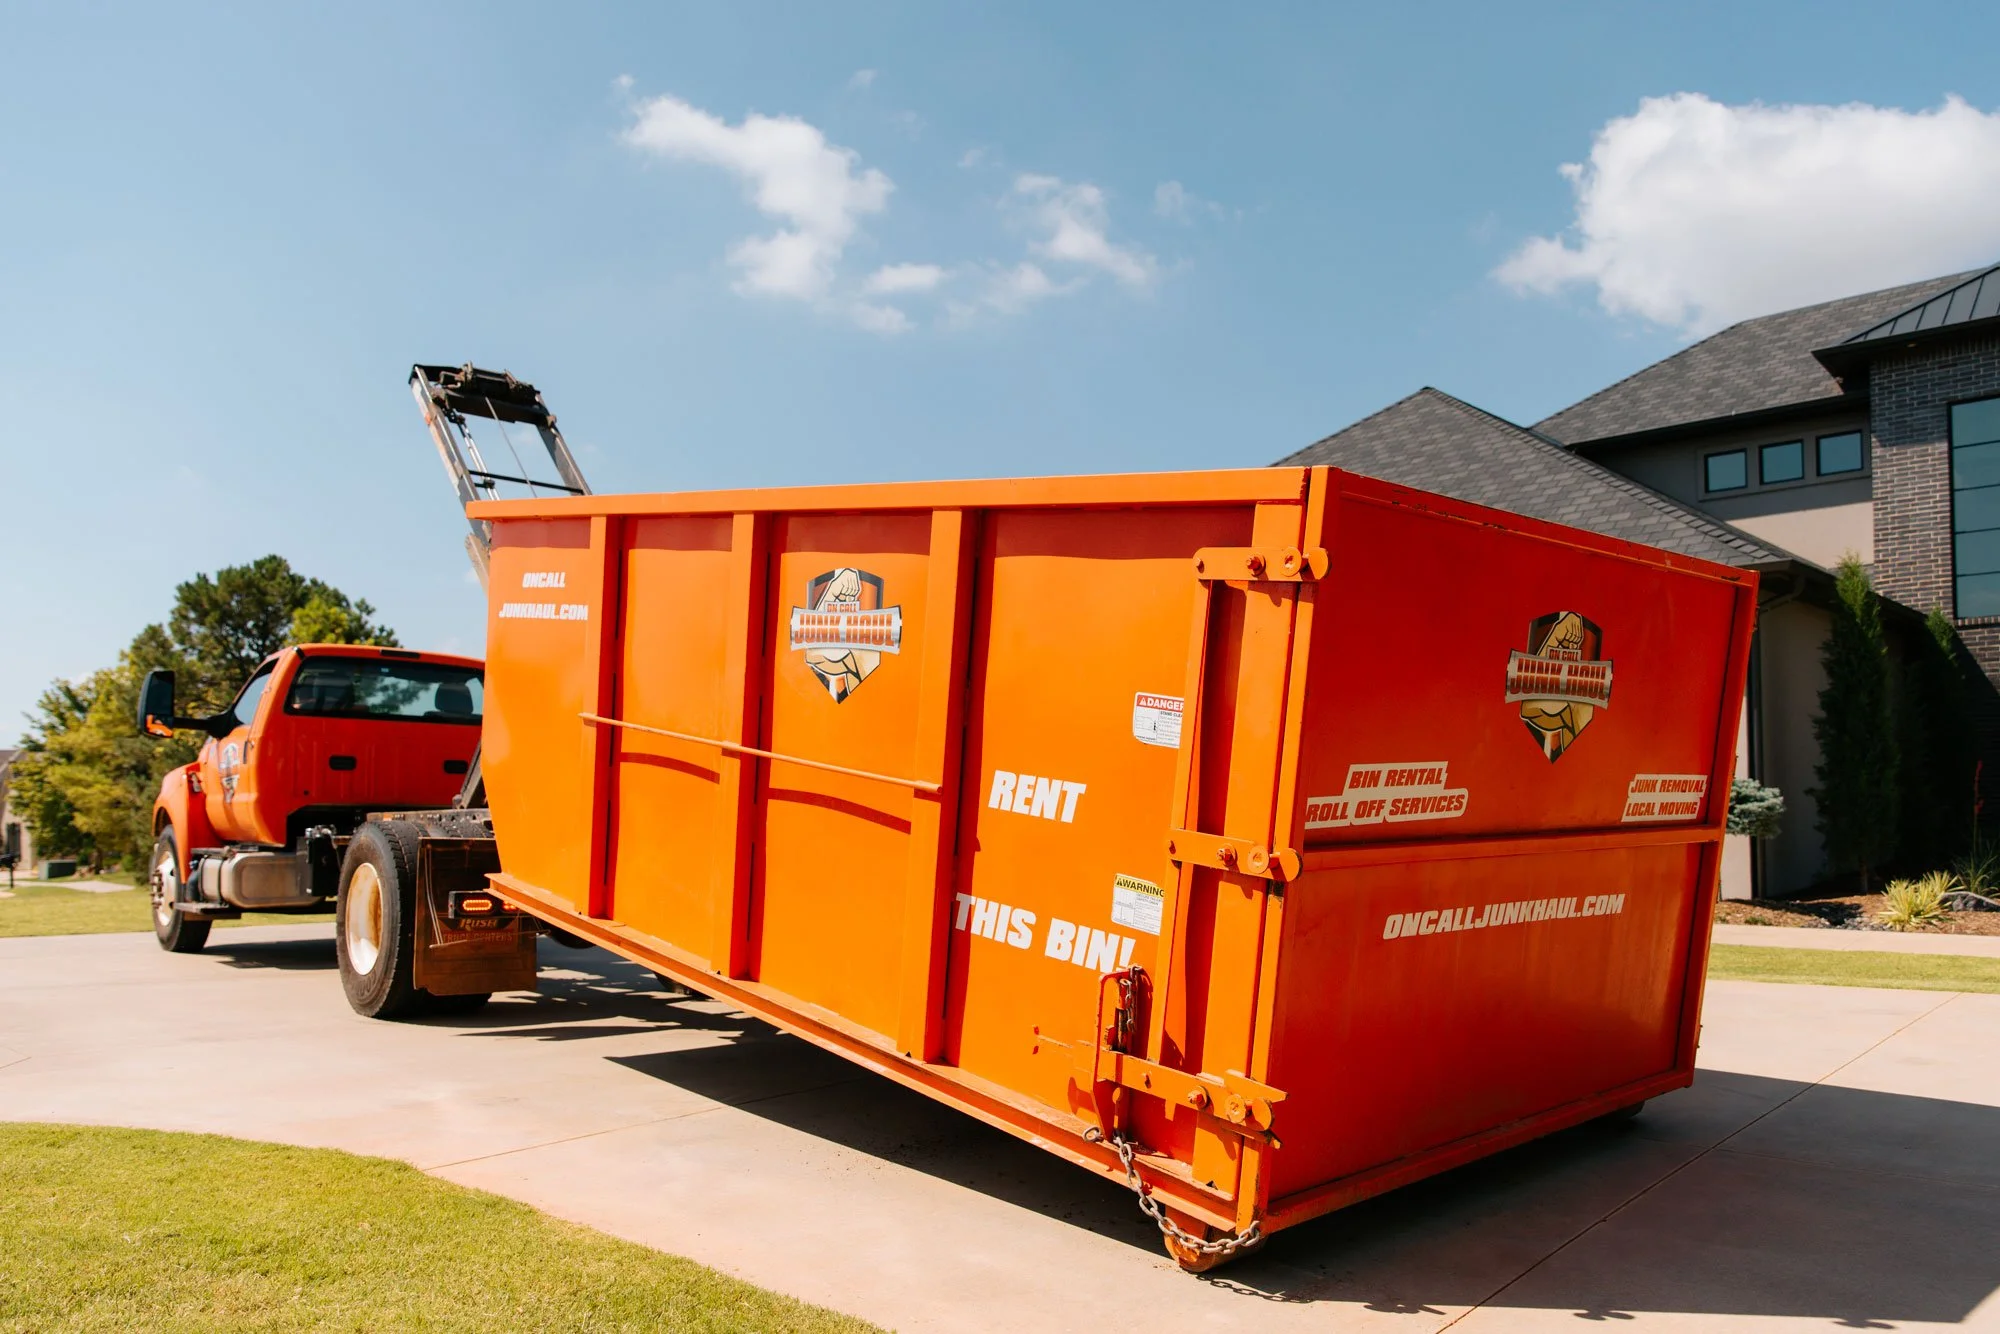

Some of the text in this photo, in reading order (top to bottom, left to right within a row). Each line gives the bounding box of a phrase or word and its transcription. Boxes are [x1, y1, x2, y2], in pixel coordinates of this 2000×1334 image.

[522, 572, 566, 588] ONCALL
[499, 603, 588, 620] JUNKHAUL.COM
[827, 603, 857, 613] ON CALL
[794, 613, 895, 646] JUNK HAUL
[1549, 648, 1579, 661] ON CALL
[1510, 658, 1607, 700] JUNK HAUL
[1349, 768, 1443, 789] BIN RENTAL
[1630, 779, 1705, 793] JUNK REMOVAL
[988, 770, 1087, 823] RENT
[1306, 794, 1466, 822] ROLL OFF SERVICES
[1625, 801, 1698, 816] LOCAL MOVING
[460, 918, 497, 931] RUSH
[1382, 893, 1625, 940] ONCALLJUNKHAUL.COM
[955, 892, 1037, 950] THIS
[1044, 917, 1137, 973] BIN!
